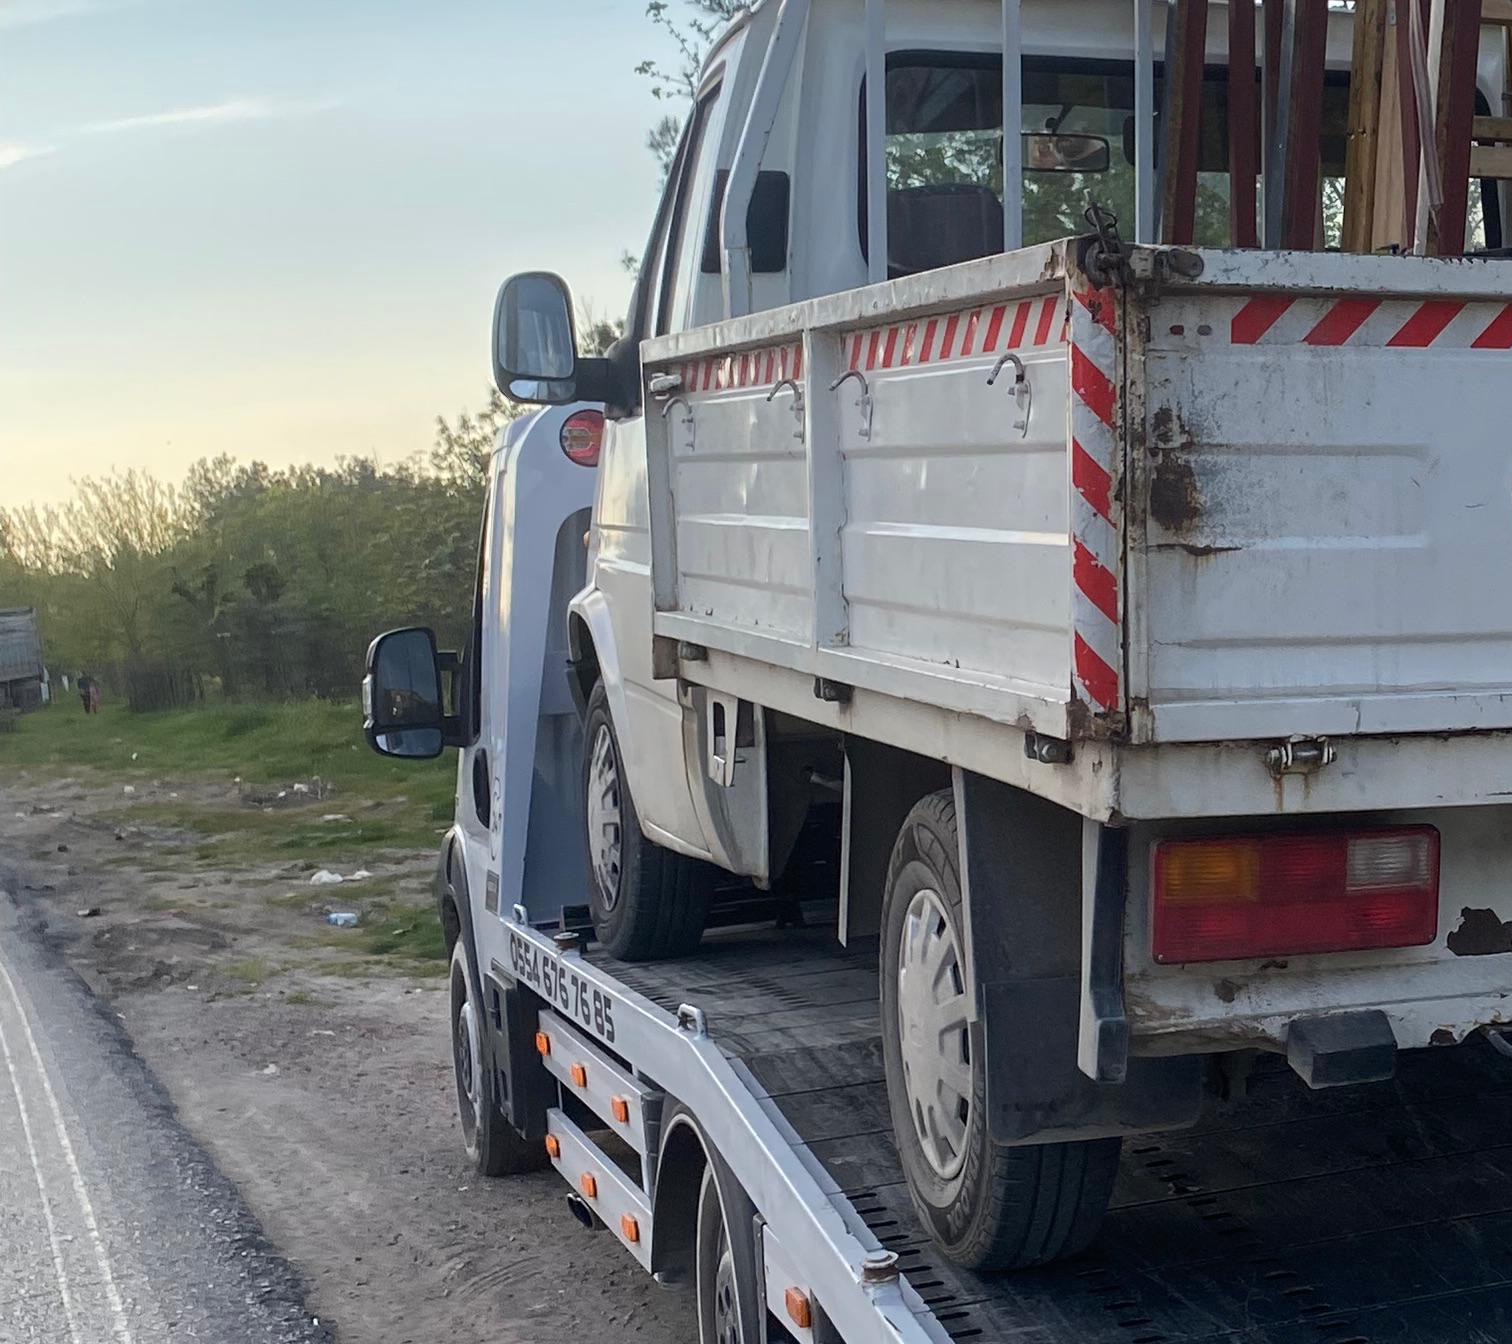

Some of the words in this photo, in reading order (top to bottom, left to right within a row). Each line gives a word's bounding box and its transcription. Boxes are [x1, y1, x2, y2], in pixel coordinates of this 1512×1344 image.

[510, 931, 541, 989] 0554
[543, 955, 569, 1010] 676
[571, 974, 591, 1026] 76
[593, 989, 616, 1044] 85
